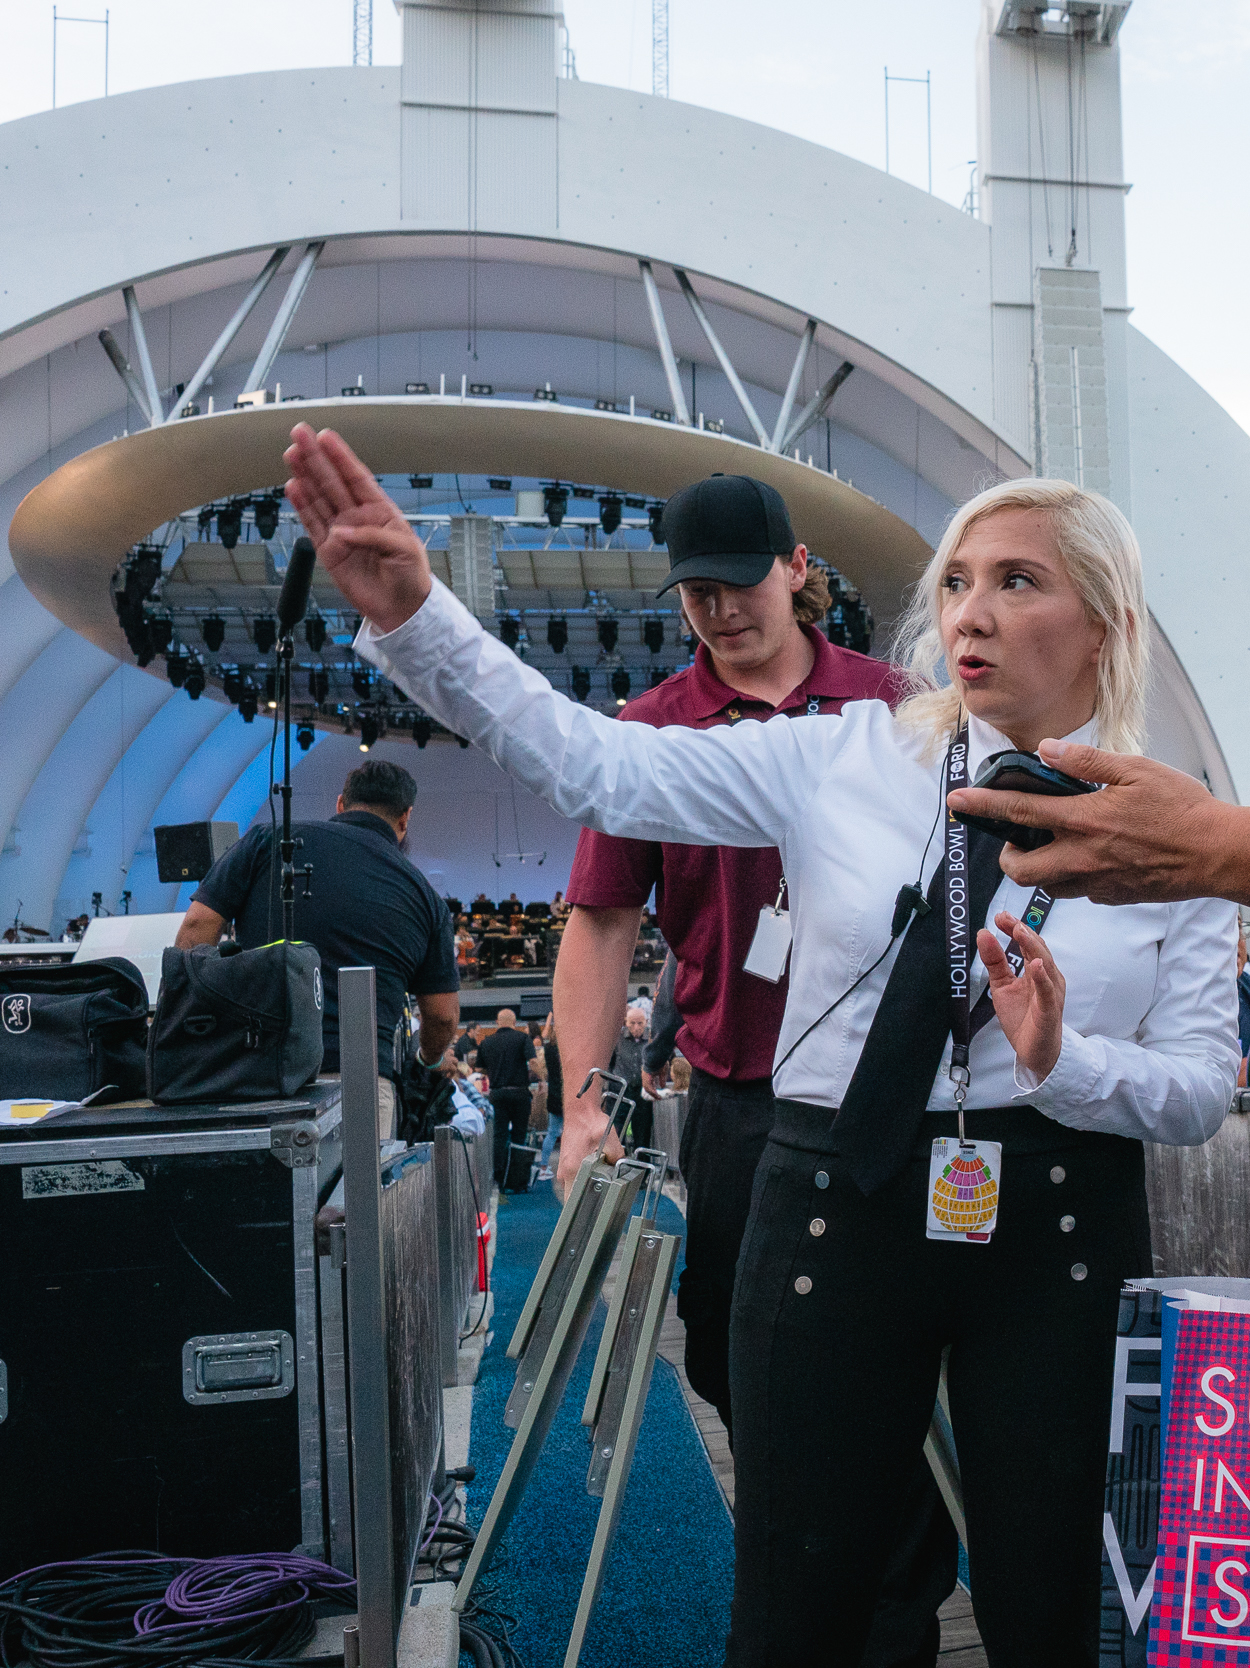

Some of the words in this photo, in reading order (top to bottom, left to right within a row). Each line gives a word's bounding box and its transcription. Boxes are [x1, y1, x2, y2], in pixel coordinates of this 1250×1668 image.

[950, 743, 966, 782] FORD
[949, 824, 965, 872] BOWL
[949, 877, 967, 998] HOLLYWOOD
